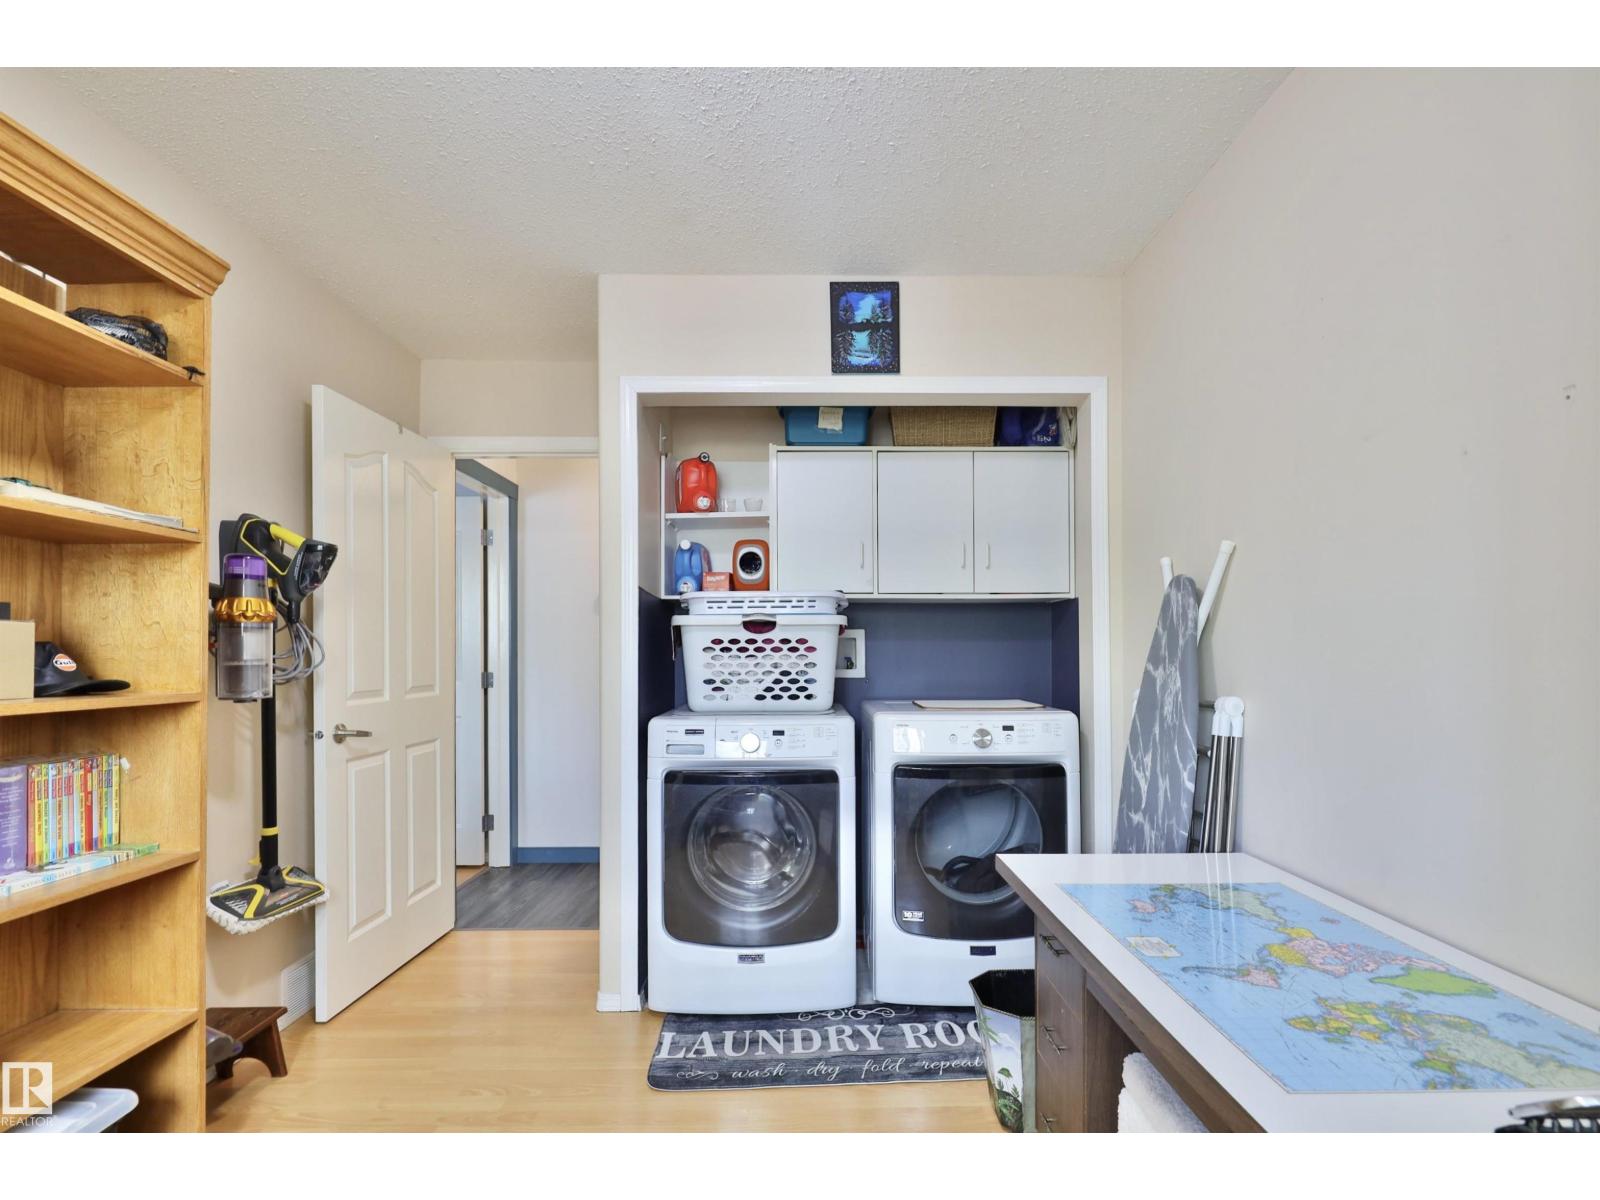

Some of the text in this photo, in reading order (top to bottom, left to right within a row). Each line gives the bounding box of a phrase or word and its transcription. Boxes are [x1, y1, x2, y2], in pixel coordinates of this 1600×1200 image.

[654, 1023, 884, 1059] LAUNDRY
[732, 1056, 983, 1081] wash dry fold repeat
